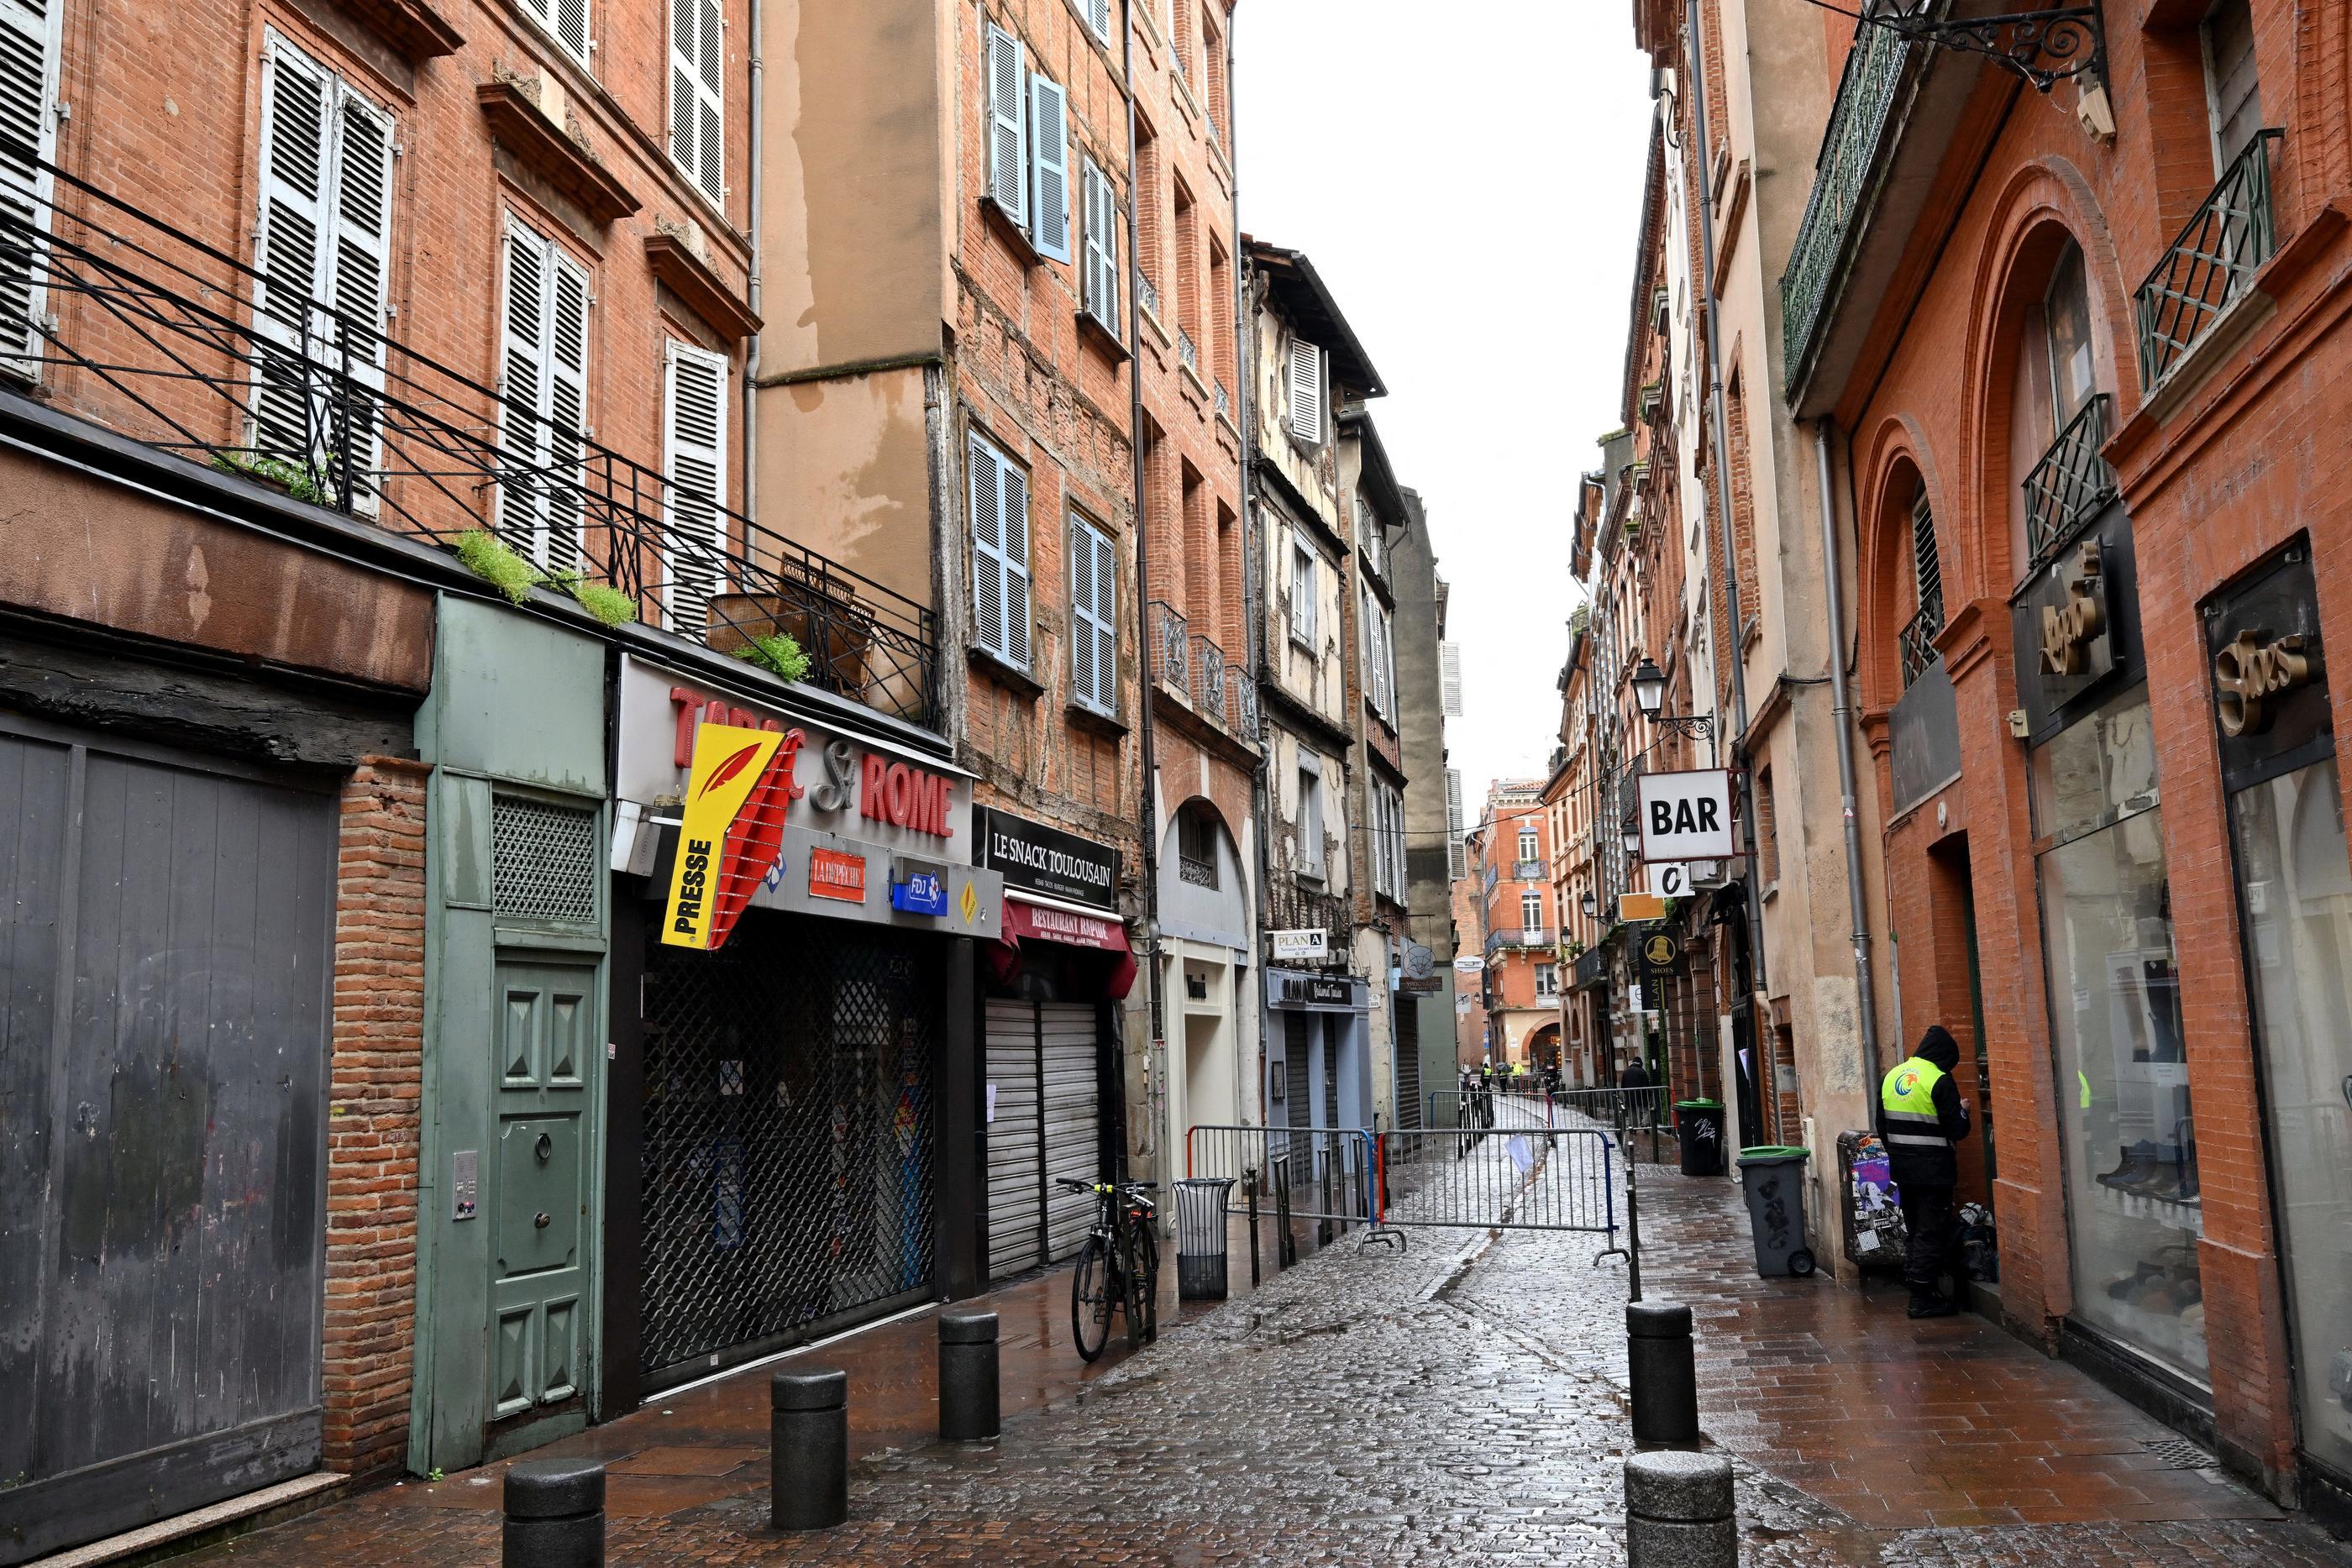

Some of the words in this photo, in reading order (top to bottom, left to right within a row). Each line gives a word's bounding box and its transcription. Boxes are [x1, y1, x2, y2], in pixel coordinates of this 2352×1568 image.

[2215, 629, 2304, 737] Shoes
[861, 753, 955, 838] ROME
[1651, 797, 1720, 835] BAR
[814, 859, 825, 883] LA
[826, 861, 862, 888] DÉPÊCHE
[994, 832, 1008, 859] LE
[1010, 837, 1047, 870] SNACK
[1048, 849, 1110, 888] TOULOUSAIN
[675, 839, 711, 935] PRESSE
[911, 878, 926, 896] FDJ
[1032, 908, 1079, 934] RESTAURANT
[1080, 917, 1109, 940] RAPIDE
[1278, 935, 1309, 947] PLAN
[1310, 934, 1321, 945] A
[1651, 978, 1660, 1008] FLAN
